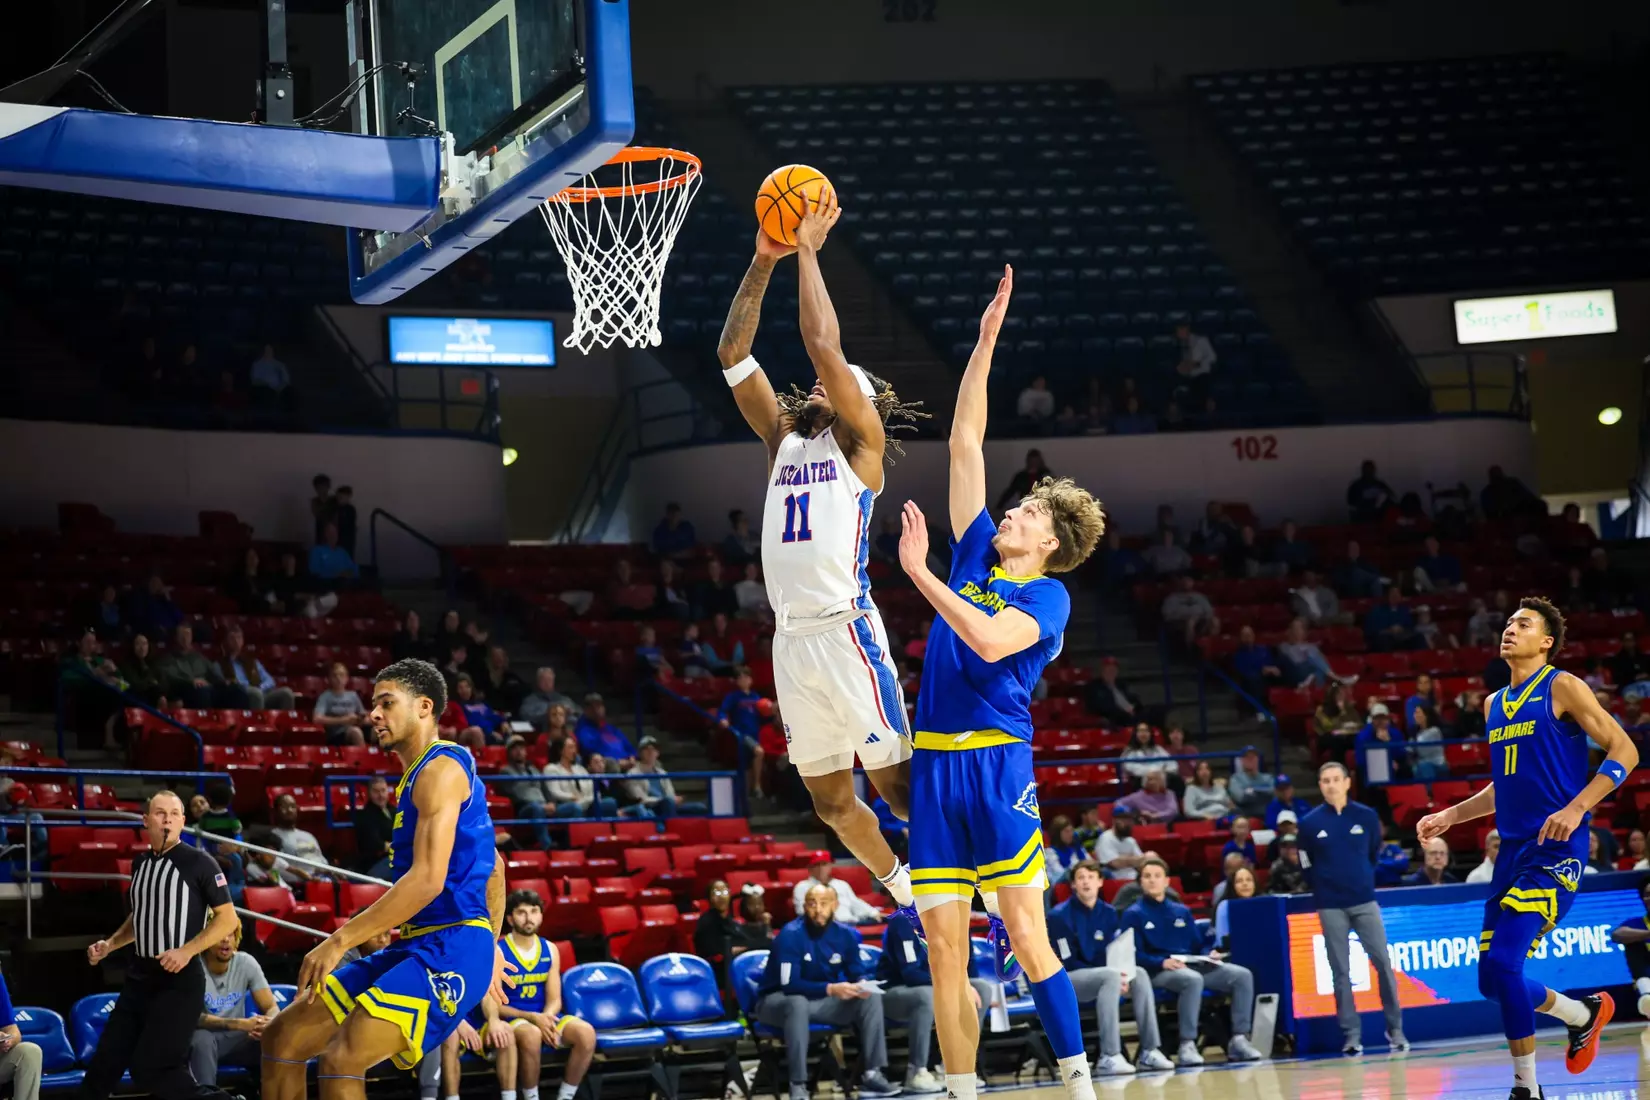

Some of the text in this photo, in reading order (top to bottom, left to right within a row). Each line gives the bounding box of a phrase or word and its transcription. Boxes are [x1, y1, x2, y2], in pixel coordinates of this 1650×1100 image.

[1524, 301, 1545, 331] 1
[1230, 434, 1278, 461] 102
[782, 492, 812, 543] 11
[1488, 720, 1537, 745] DELAWARE
[1504, 744, 1518, 776] 11
[1551, 924, 1614, 958] SPINE
